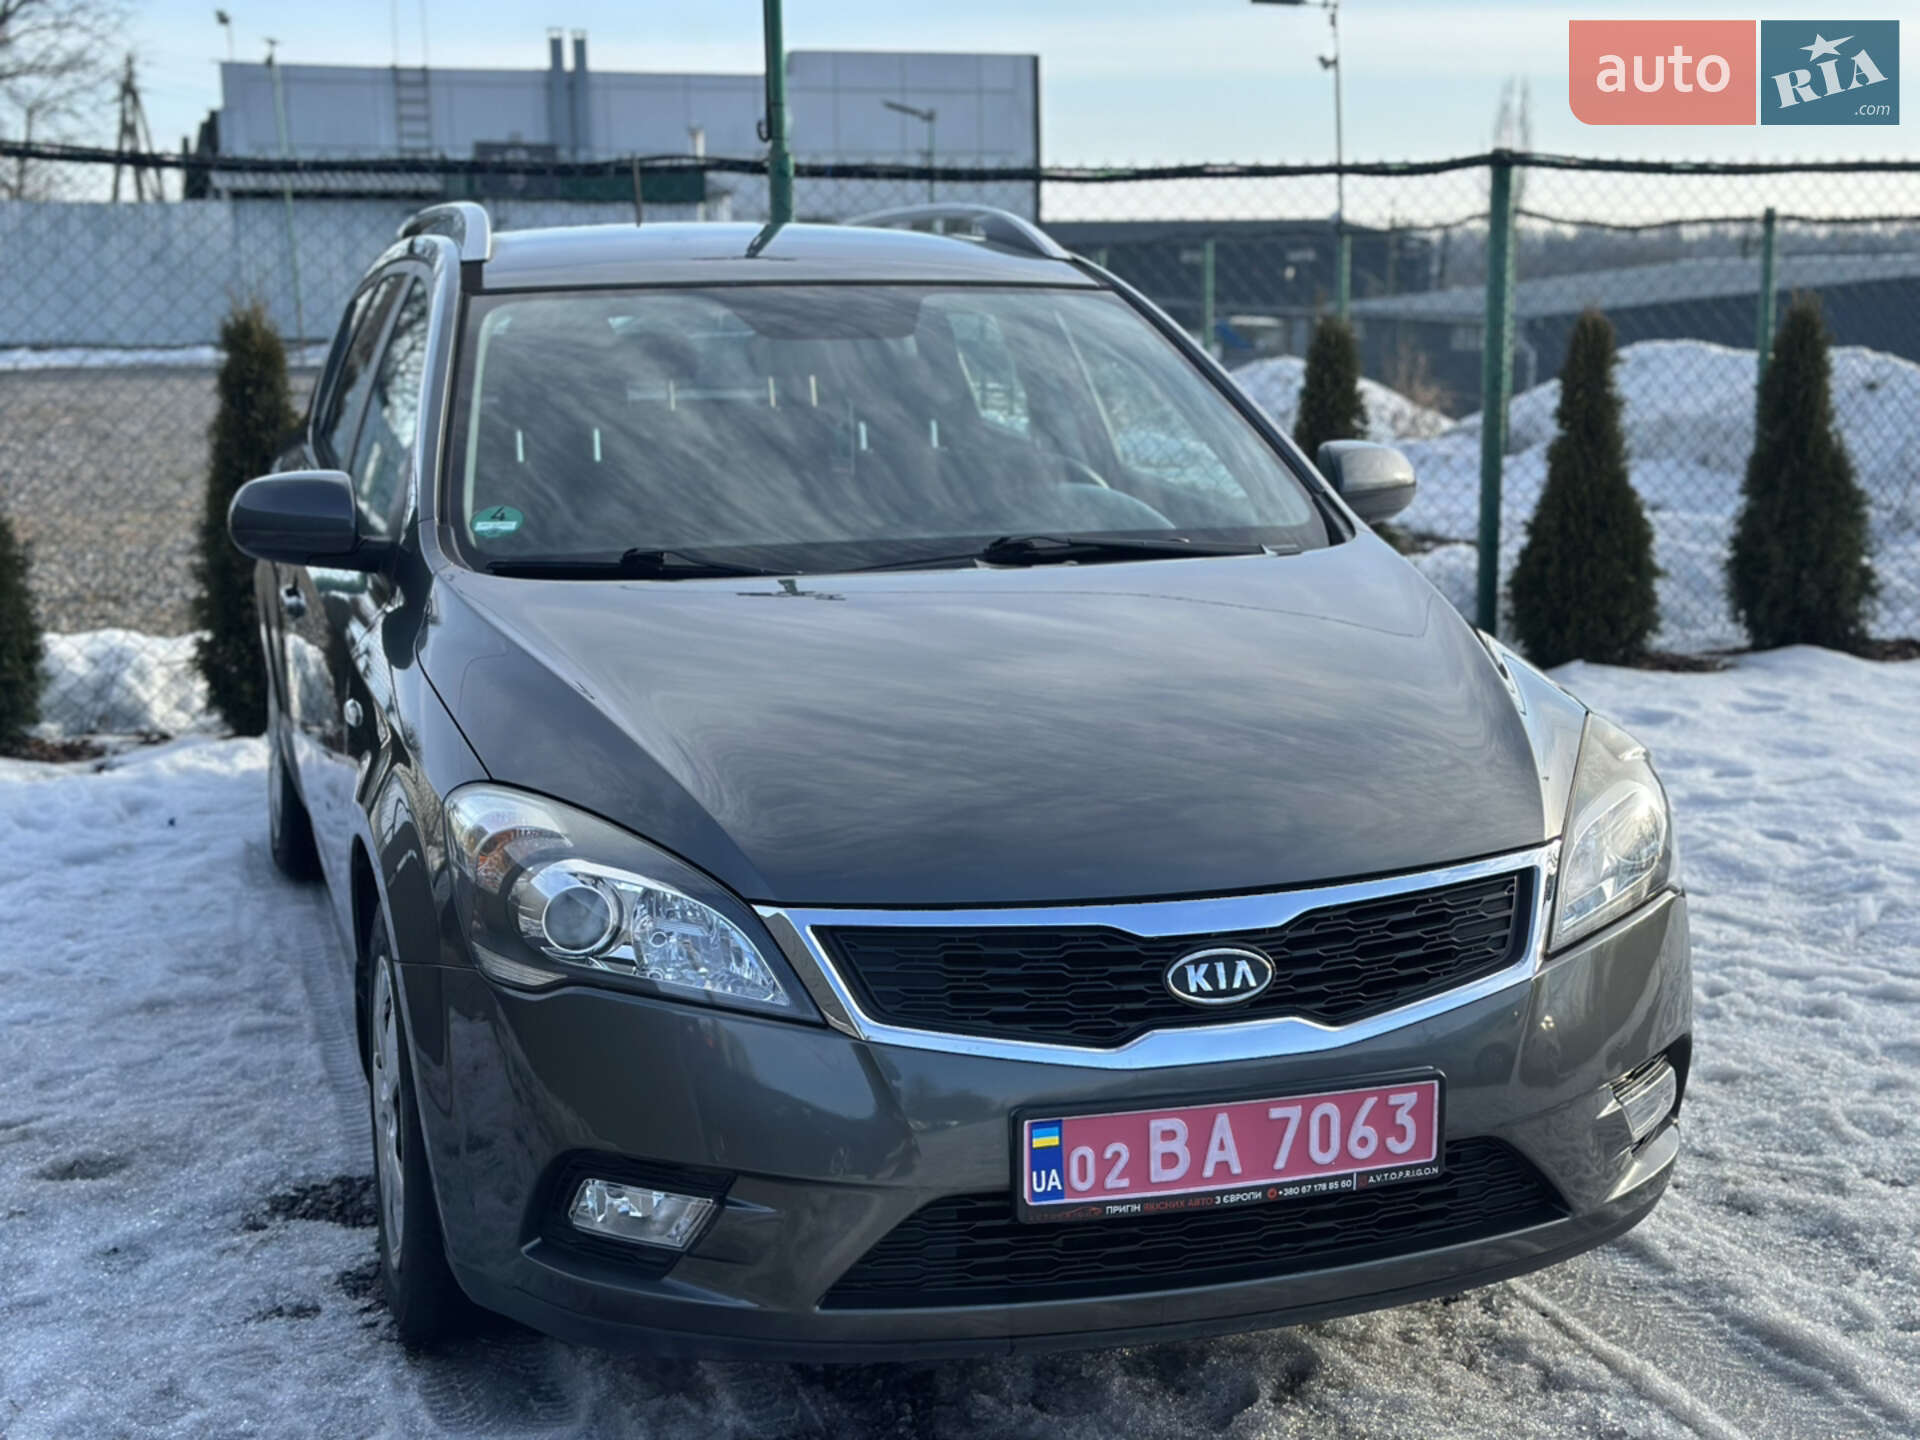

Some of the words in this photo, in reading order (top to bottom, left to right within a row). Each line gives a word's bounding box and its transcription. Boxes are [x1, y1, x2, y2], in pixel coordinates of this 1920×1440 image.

[1184, 959, 1257, 993] KIA
[1069, 1142, 1130, 1192] 02
[1149, 1112, 1242, 1183] BA
[1269, 1091, 1418, 1171] 7063
[1032, 1169, 1062, 1192] UA
[1278, 1186, 1300, 1197] +380
